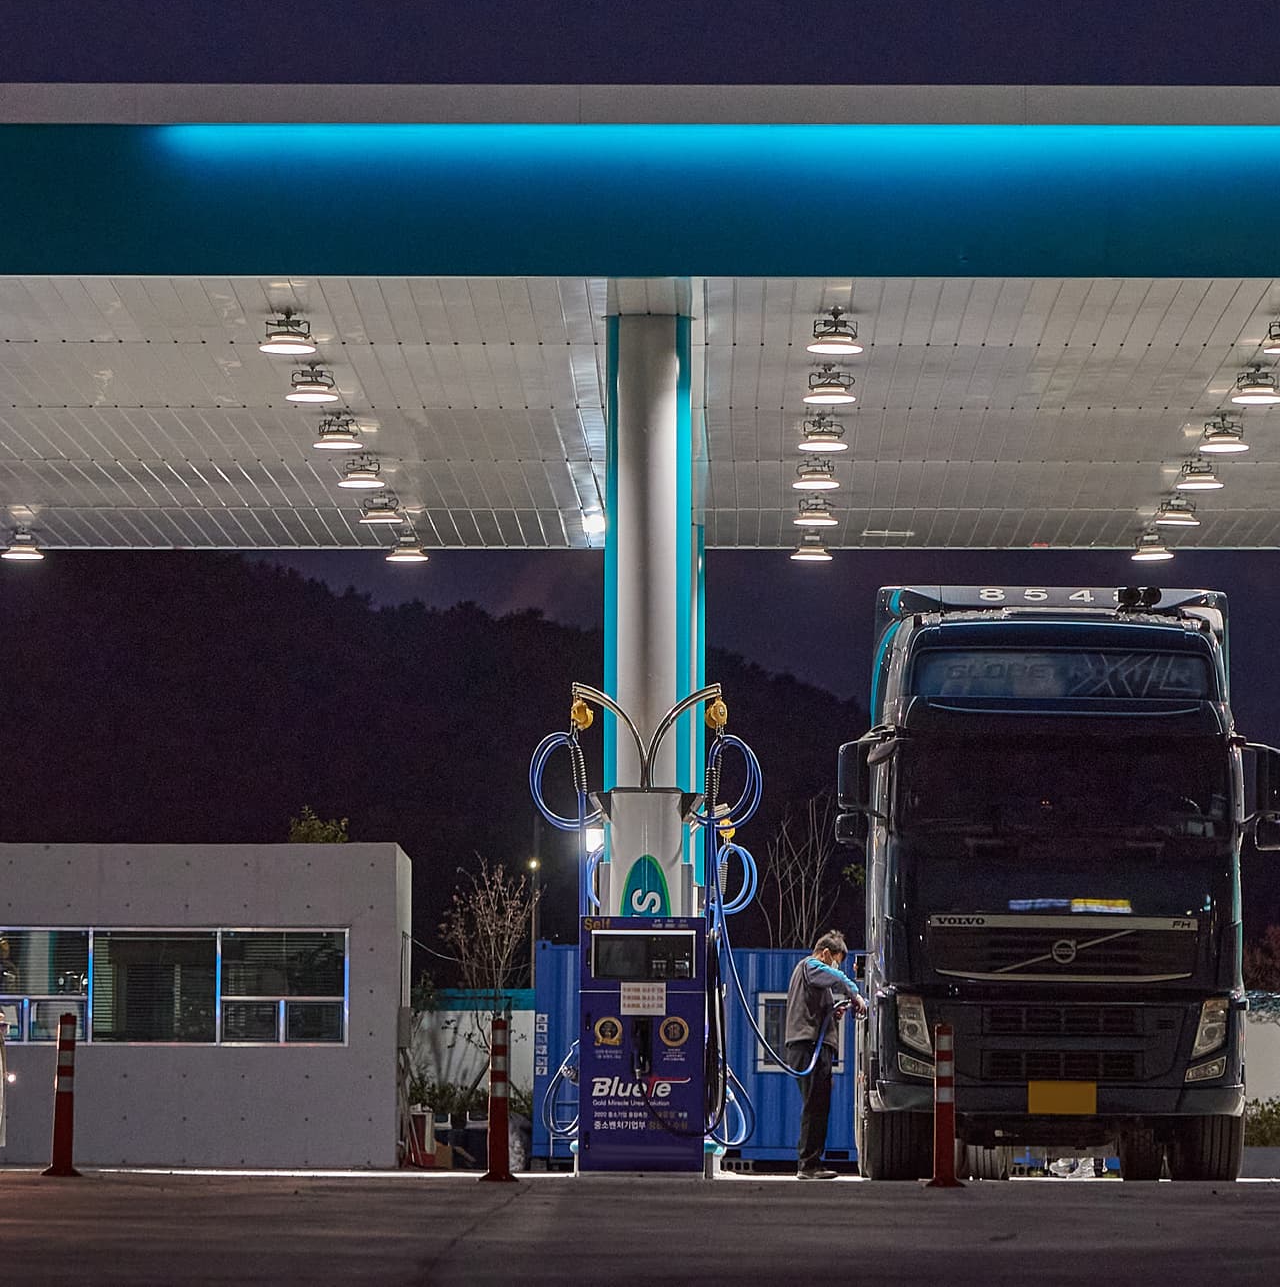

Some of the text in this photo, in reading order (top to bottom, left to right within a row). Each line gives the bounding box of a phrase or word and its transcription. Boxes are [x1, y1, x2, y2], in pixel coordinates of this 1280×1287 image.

[584, 918, 611, 931] Self
[936, 917, 985, 925] VOLVO
[1172, 920, 1191, 928] FH
